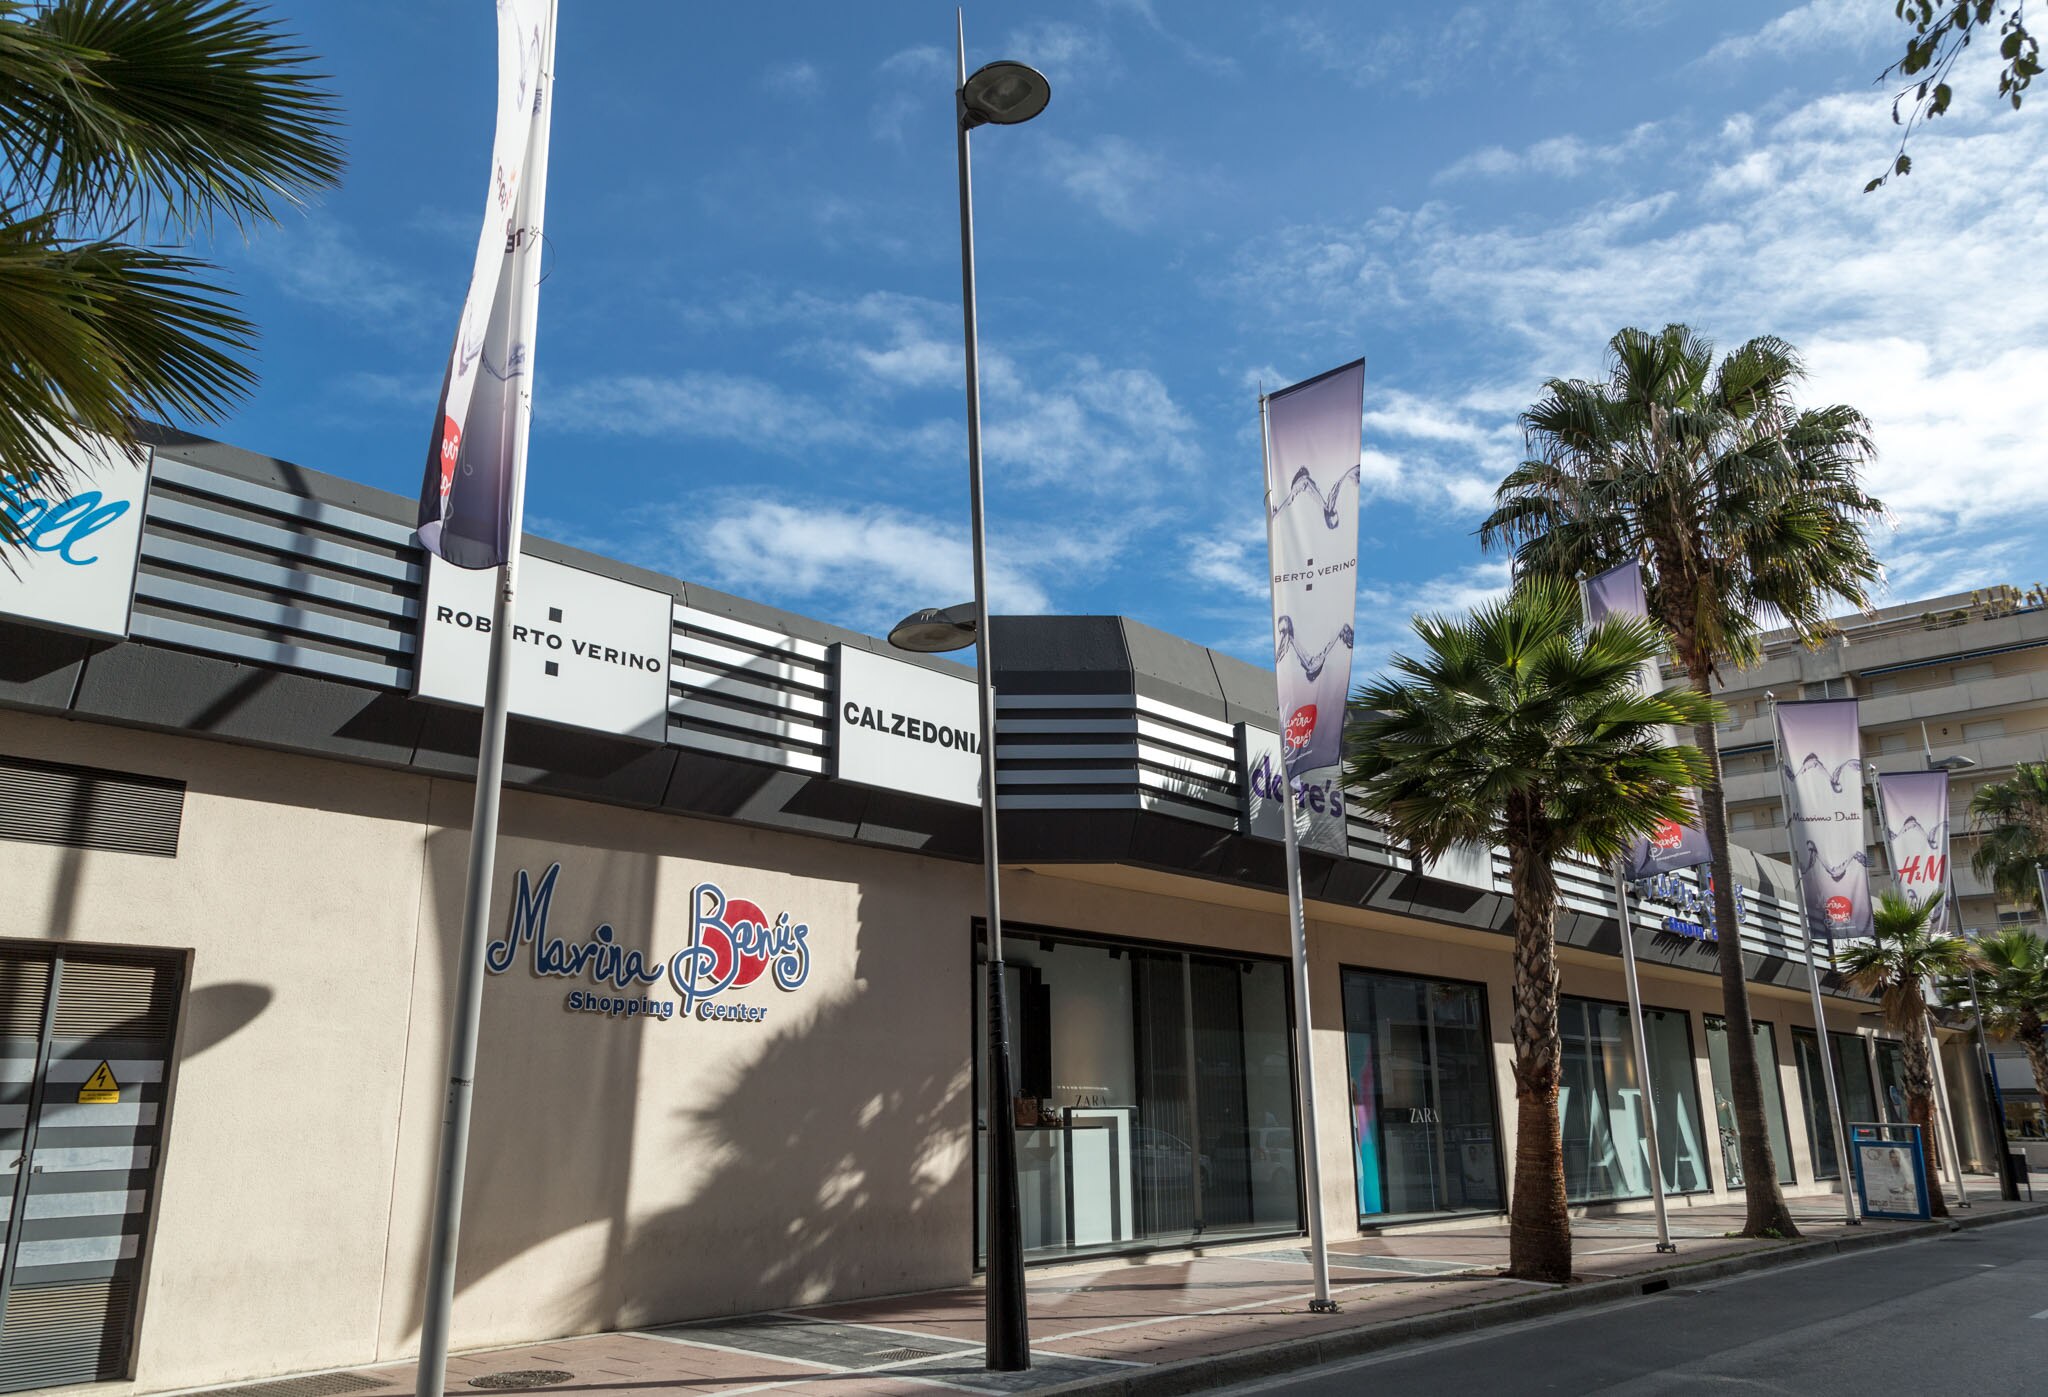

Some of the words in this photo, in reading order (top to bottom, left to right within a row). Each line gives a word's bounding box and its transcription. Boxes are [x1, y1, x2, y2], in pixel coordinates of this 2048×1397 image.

[1274, 571, 1314, 583] BERTO
[1317, 558, 1356, 576] VERINO
[437, 605, 563, 650] ROBRTO
[571, 639, 662, 673] VERINO
[1251, 755, 1343, 818] clare's
[1792, 812, 1832, 822] Massimo
[1834, 811, 1862, 823] Dutti
[1897, 854, 1947, 885] H&M
[486, 862, 665, 990] Marina
[567, 991, 675, 1018] Shopping
[700, 1000, 769, 1021] Center
[1075, 1095, 1108, 1107] ZARA
[1409, 1107, 1440, 1124] ZARA
